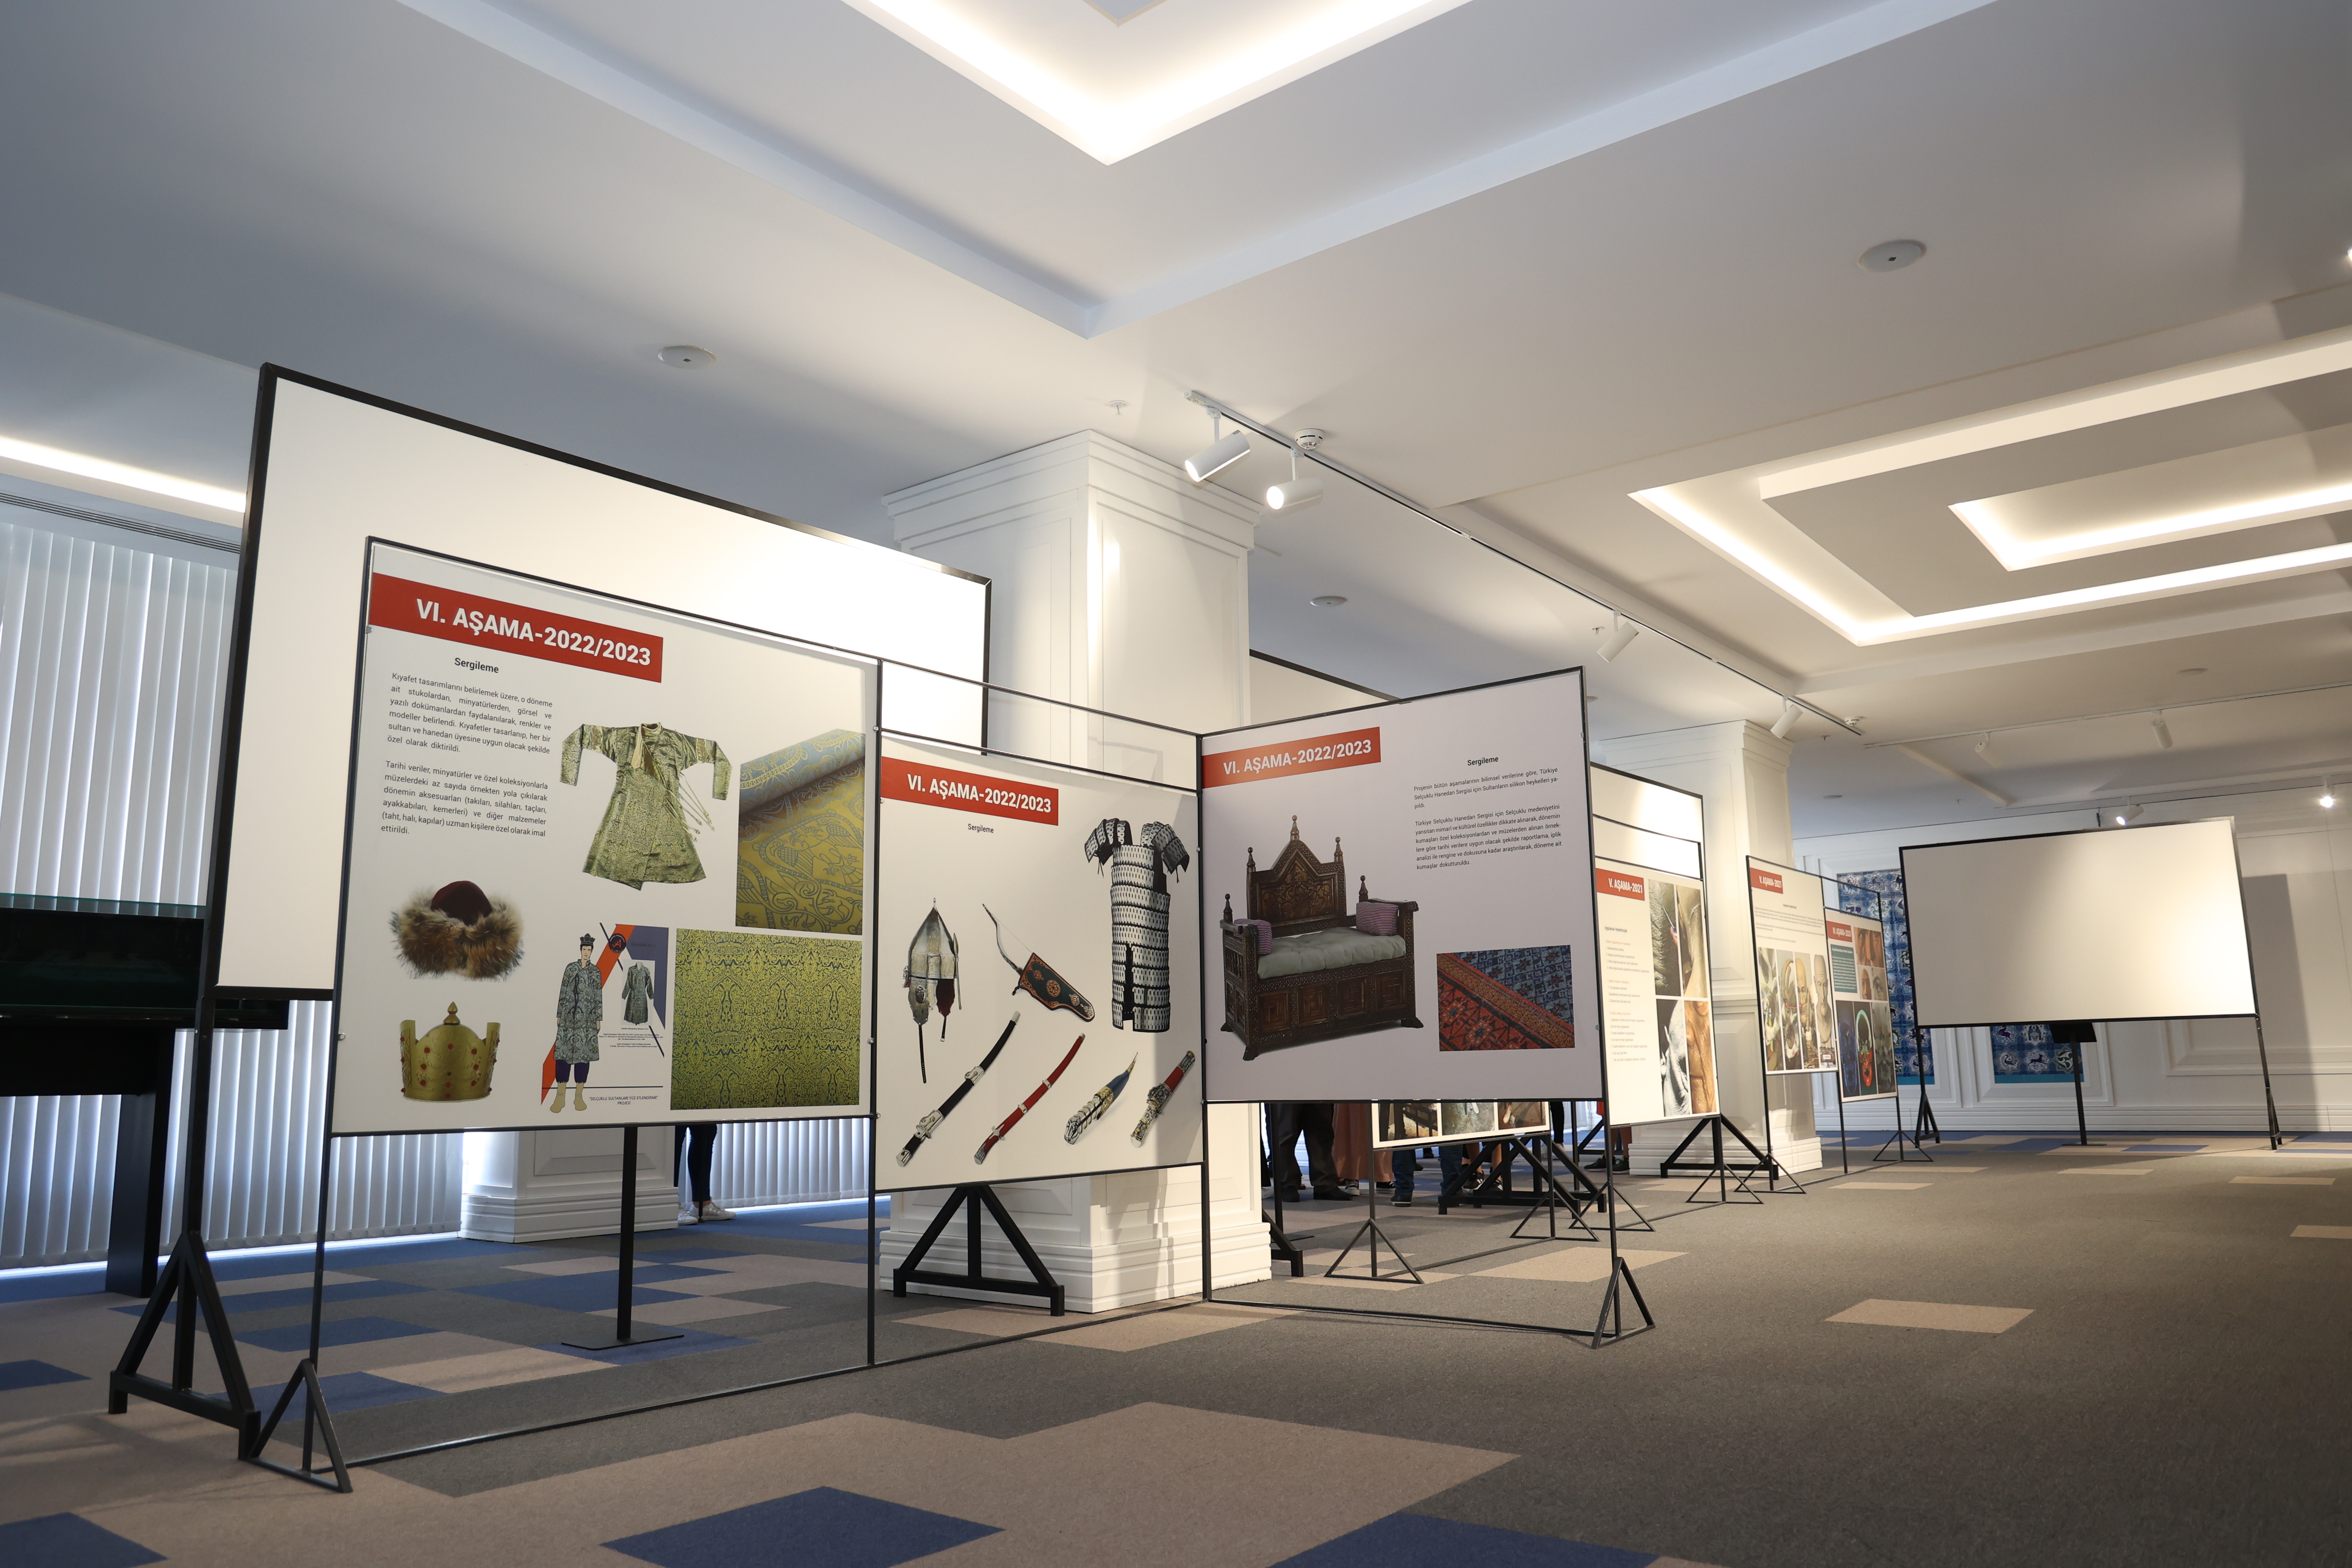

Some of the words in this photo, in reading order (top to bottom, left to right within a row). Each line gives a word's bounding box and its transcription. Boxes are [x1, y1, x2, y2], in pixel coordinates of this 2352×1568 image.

[416, 598, 446, 624] VI.
[452, 607, 651, 667] AŞAMA-2022/2023
[454, 658, 499, 674] Sergileme
[392, 672, 417, 683] Kıyafet
[419, 678, 462, 691] tasarımlarını
[464, 685, 499, 698] belirlemek
[500, 692, 520, 702] üzere,
[527, 697, 553, 707] döneme
[408, 689, 451, 702] stukolardan,
[459, 698, 511, 713] minyatürlerden,
[518, 708, 538, 717] görsel
[390, 698, 409, 707] yazılı
[411, 701, 466, 717] dokümanlardan
[469, 710, 517, 726] faydalanılarak,
[519, 720, 542, 729] renkler
[389, 711, 421, 721] modeller
[423, 715, 456, 727] belirlendi.
[459, 721, 492, 732] Kıyafetler
[493, 727, 527, 739] tasarlanıp,
[530, 732, 540, 741] her
[387, 735, 402, 744] özel
[405, 738, 428, 747] olarak
[431, 741, 460, 752] diktirildi.
[388, 723, 411, 732] sultan
[423, 727, 453, 739] hanedan
[454, 733, 481, 743] üyesine
[482, 738, 503, 747] uygun
[504, 741, 526, 750] olacak
[527, 745, 550, 754] şekilde
[1223, 761, 1240, 775] VI.
[1243, 739, 1372, 774] AŞAMA-2022/2023
[1467, 756, 1499, 766] Sergileme
[386, 760, 406, 770] Tarihi
[408, 765, 431, 774] veriler,
[433, 768, 472, 779] minyatürler
[484, 775, 498, 783] özel
[499, 776, 548, 790] koleksiyonlarla
[1449, 778, 1479, 787] aşamalarının
[1526, 777, 1550, 786] heykelleri
[385, 774, 429, 786] müzelerdeki
[444, 783, 466, 791] sayıda
[470, 785, 500, 795] örnekten
[520, 792, 548, 801] çıkılarak
[907, 774, 926, 792] VI.
[929, 778, 1051, 813] AŞAMA-2022/2023
[383, 786, 416, 796] dönemin
[419, 790, 462, 802] aksesuarları
[465, 796, 492, 807] (takıları,
[495, 800, 522, 811] silahları,
[525, 805, 547, 814] taçları,
[1528, 803, 1560, 813] medeniyetini
[383, 800, 428, 812] ayakkabıları,
[433, 805, 468, 817] kemerleri)
[486, 812, 504, 821] diğer
[508, 815, 546, 825] malzemeler
[381, 825, 409, 834] ettirildi.
[382, 811, 401, 821] (taht,
[402, 814, 417, 823] halı,
[418, 815, 445, 827] kapılar)
[470, 821, 495, 831] kişilere
[510, 827, 531, 835] olarak
[532, 829, 545, 837] imal
[968, 823, 994, 834] Sergileme
[1450, 830, 1490, 840] koleksiyonlardan
[1498, 826, 1527, 834] müzelerden
[1502, 836, 1520, 844] şekilde
[1521, 833, 1550, 842] raportlama,
[1502, 843, 1533, 852] araştırılarak,
[1439, 859, 1470, 868] dokutturuldu.
[1608, 878, 1614, 888] V.
[1614, 879, 1643, 894] AŞAMA-2021
[1759, 875, 1763, 884] V.
[1763, 876, 1782, 888] AŞAMA-2021
